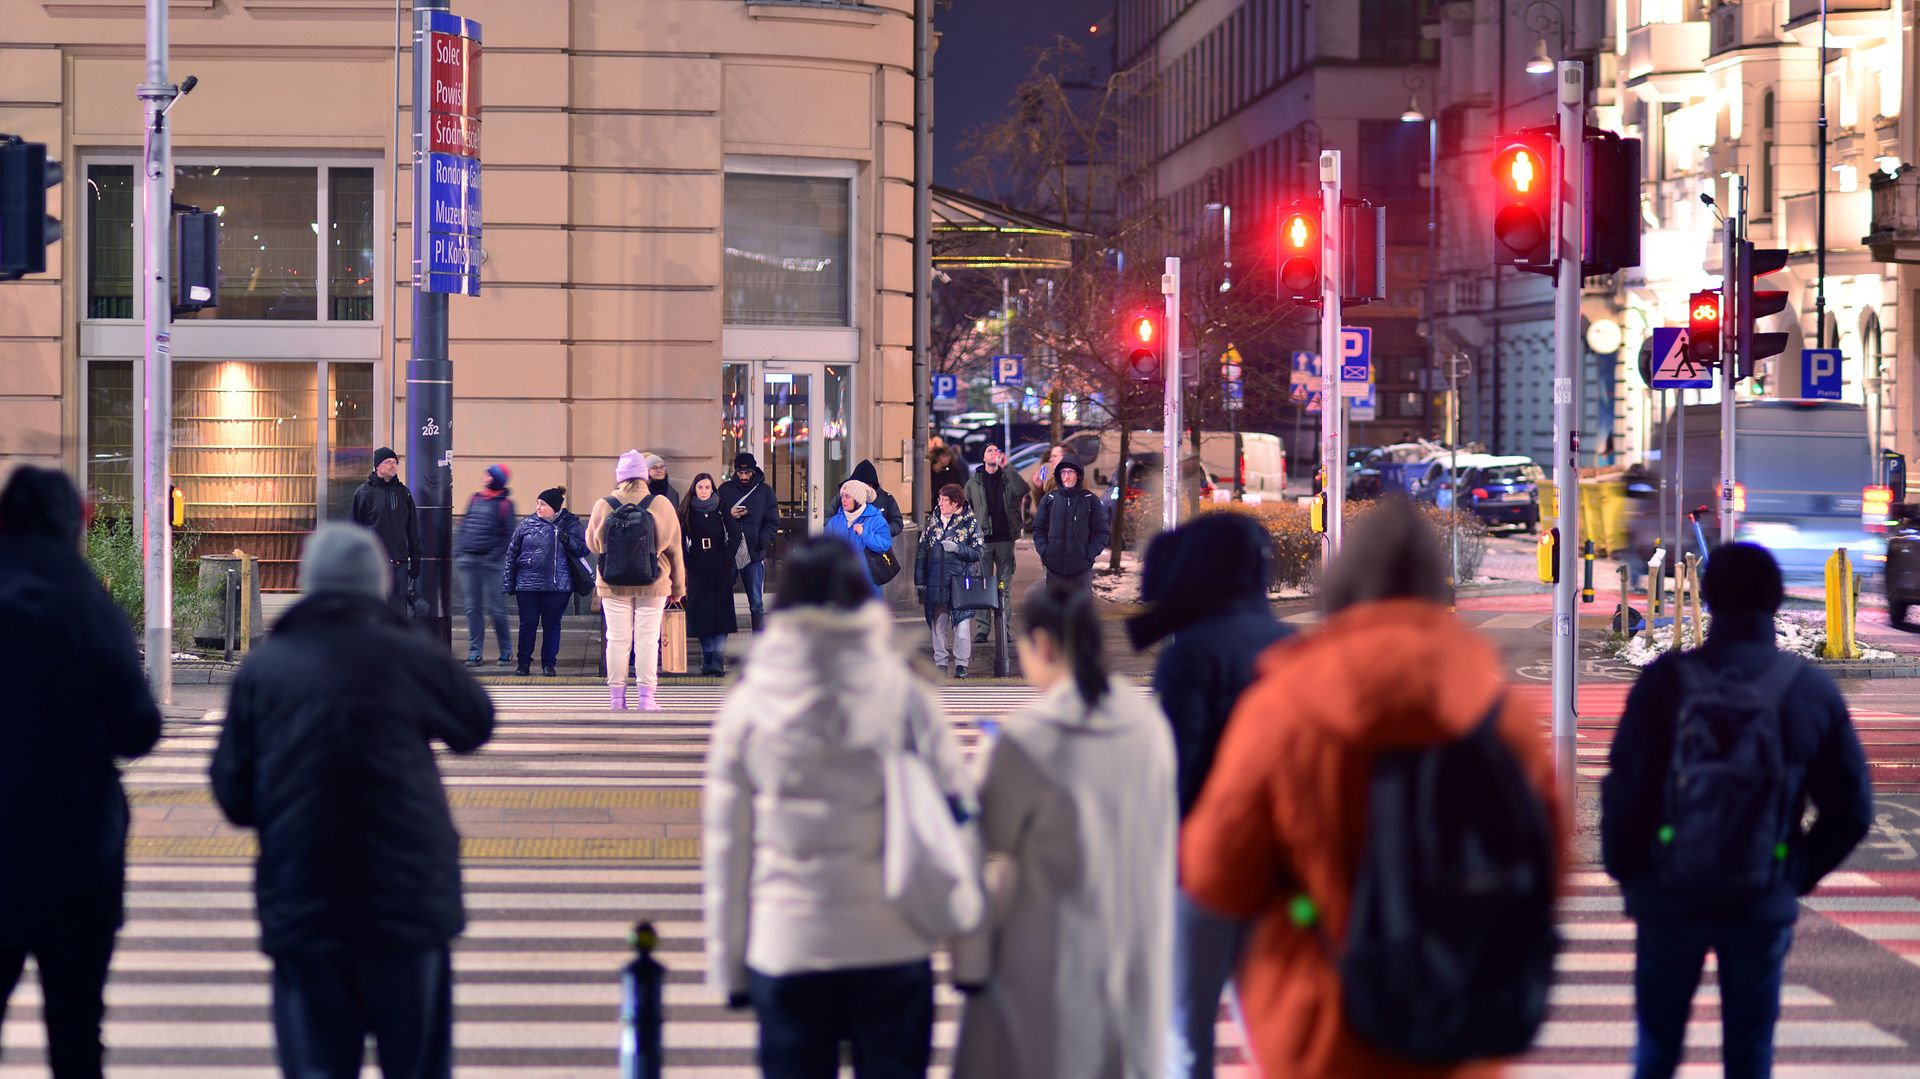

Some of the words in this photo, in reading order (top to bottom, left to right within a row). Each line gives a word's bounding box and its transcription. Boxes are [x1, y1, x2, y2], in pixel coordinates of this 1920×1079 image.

[436, 39, 460, 66] Solec
[436, 159, 462, 186] Rondo
[1341, 331, 1363, 366] P
[999, 357, 1018, 384] P
[1810, 353, 1835, 386] P
[938, 376, 953, 396] P
[422, 425, 440, 436] 202
[427, 417, 434, 427] 2
